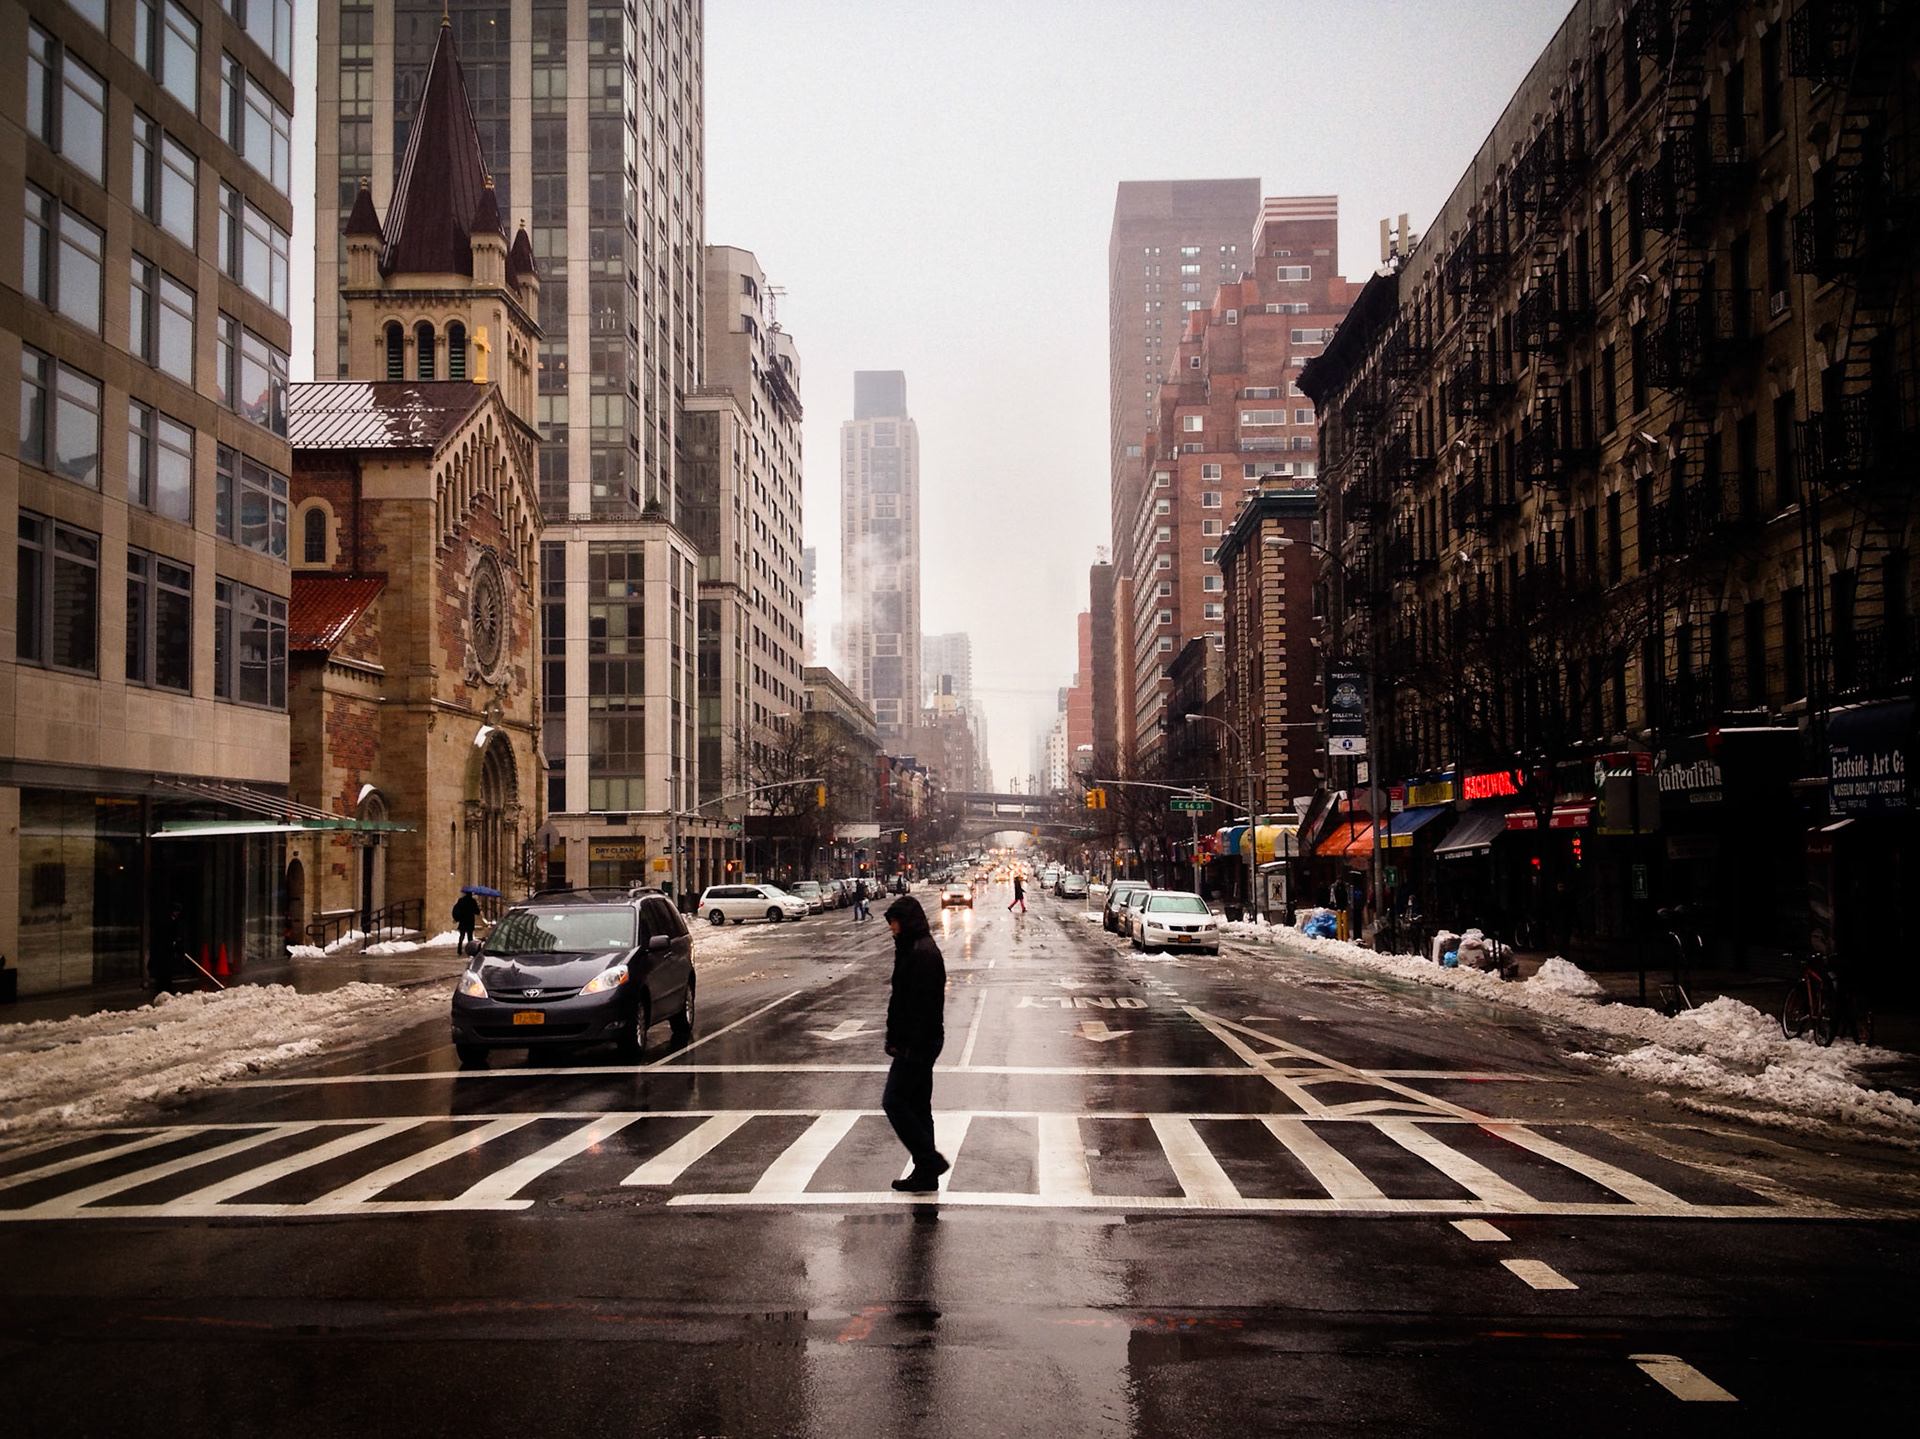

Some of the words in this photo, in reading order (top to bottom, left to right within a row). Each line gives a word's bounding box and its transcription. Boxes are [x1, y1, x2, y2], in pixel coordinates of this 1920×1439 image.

[1832, 754, 1869, 779] Eastside
[1872, 752, 1890, 776] Art
[1834, 783, 1854, 796] MUSEUM
[1855, 781, 1877, 795] QUALITY
[1878, 779, 1900, 794] CUSTOM
[1016, 997, 1148, 1009] ONLY
